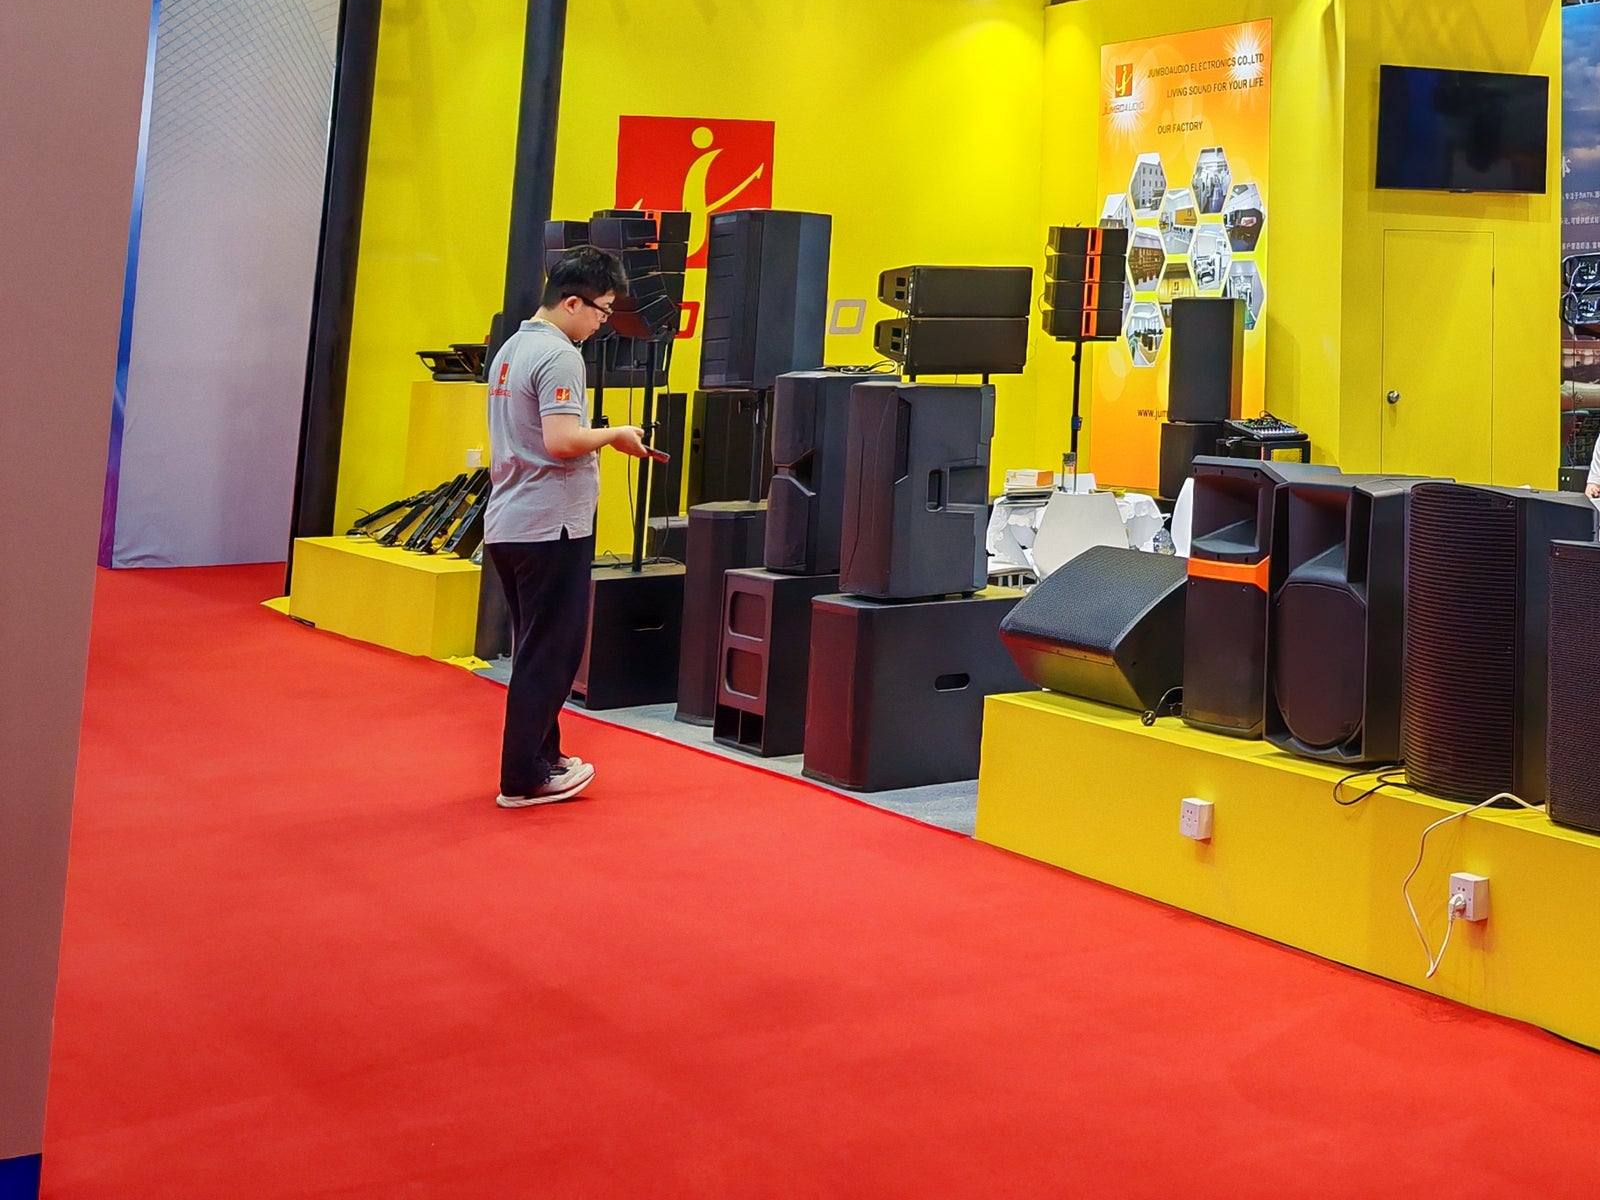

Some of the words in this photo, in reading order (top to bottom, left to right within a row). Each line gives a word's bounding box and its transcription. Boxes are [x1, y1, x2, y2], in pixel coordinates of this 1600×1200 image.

[1148, 64, 1190, 79] JUMBOAUDIO
[1190, 57, 1236, 73] ELECTRONICS
[1166, 87, 1188, 99] LIVING
[1189, 84, 1212, 97] SOUND
[1213, 82, 1227, 93] FOR
[1228, 79, 1248, 91] YOUR
[1249, 76, 1265, 89] LIFE
[1158, 124, 1171, 135] OUR
[1172, 120, 1204, 134] FACTORY
